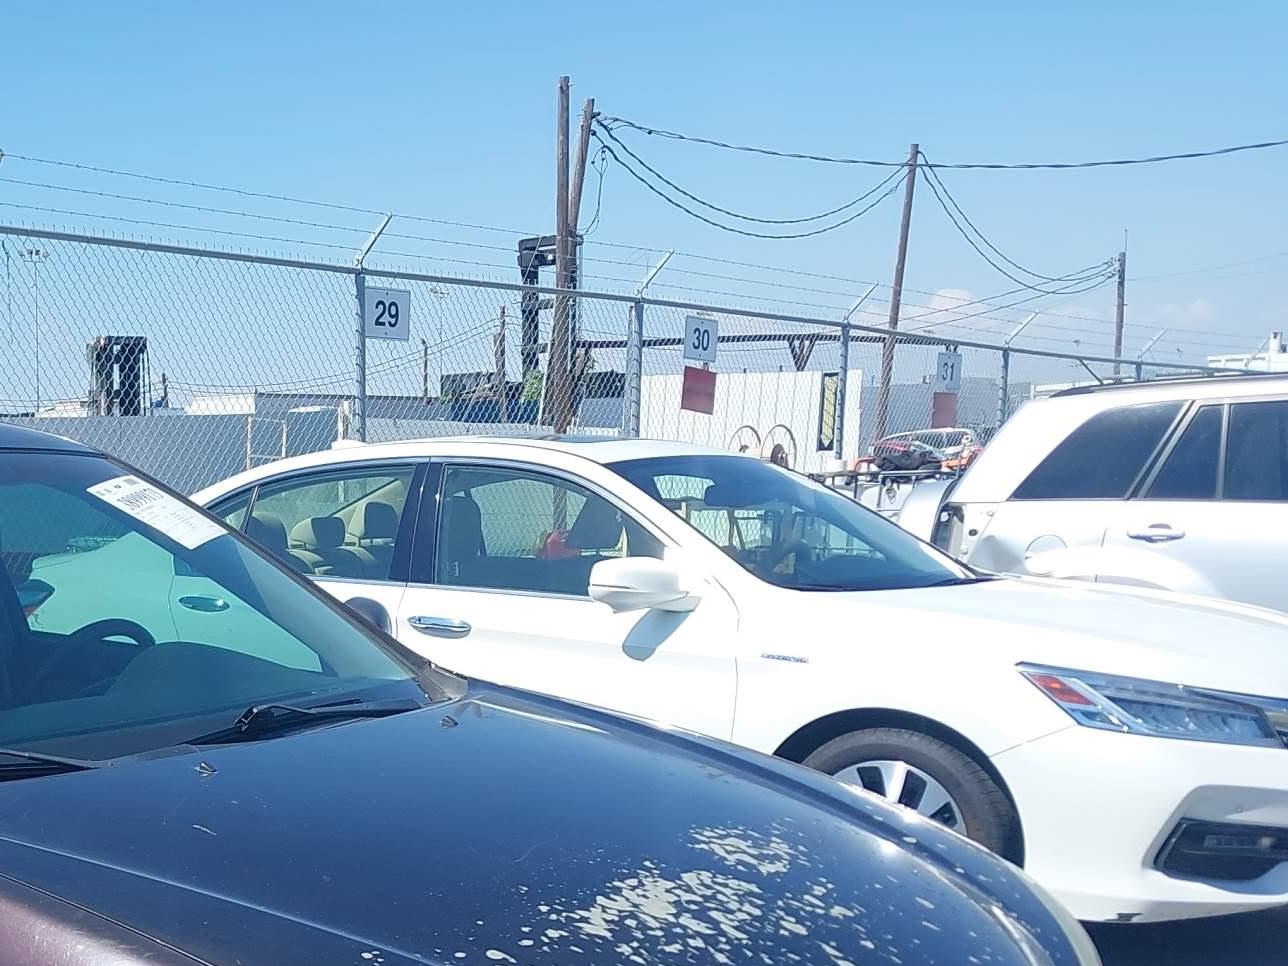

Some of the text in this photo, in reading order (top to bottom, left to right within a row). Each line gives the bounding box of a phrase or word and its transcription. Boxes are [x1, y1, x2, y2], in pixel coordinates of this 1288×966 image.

[374, 299, 399, 328] 29
[692, 327, 710, 351] 30
[942, 362, 955, 381] 31
